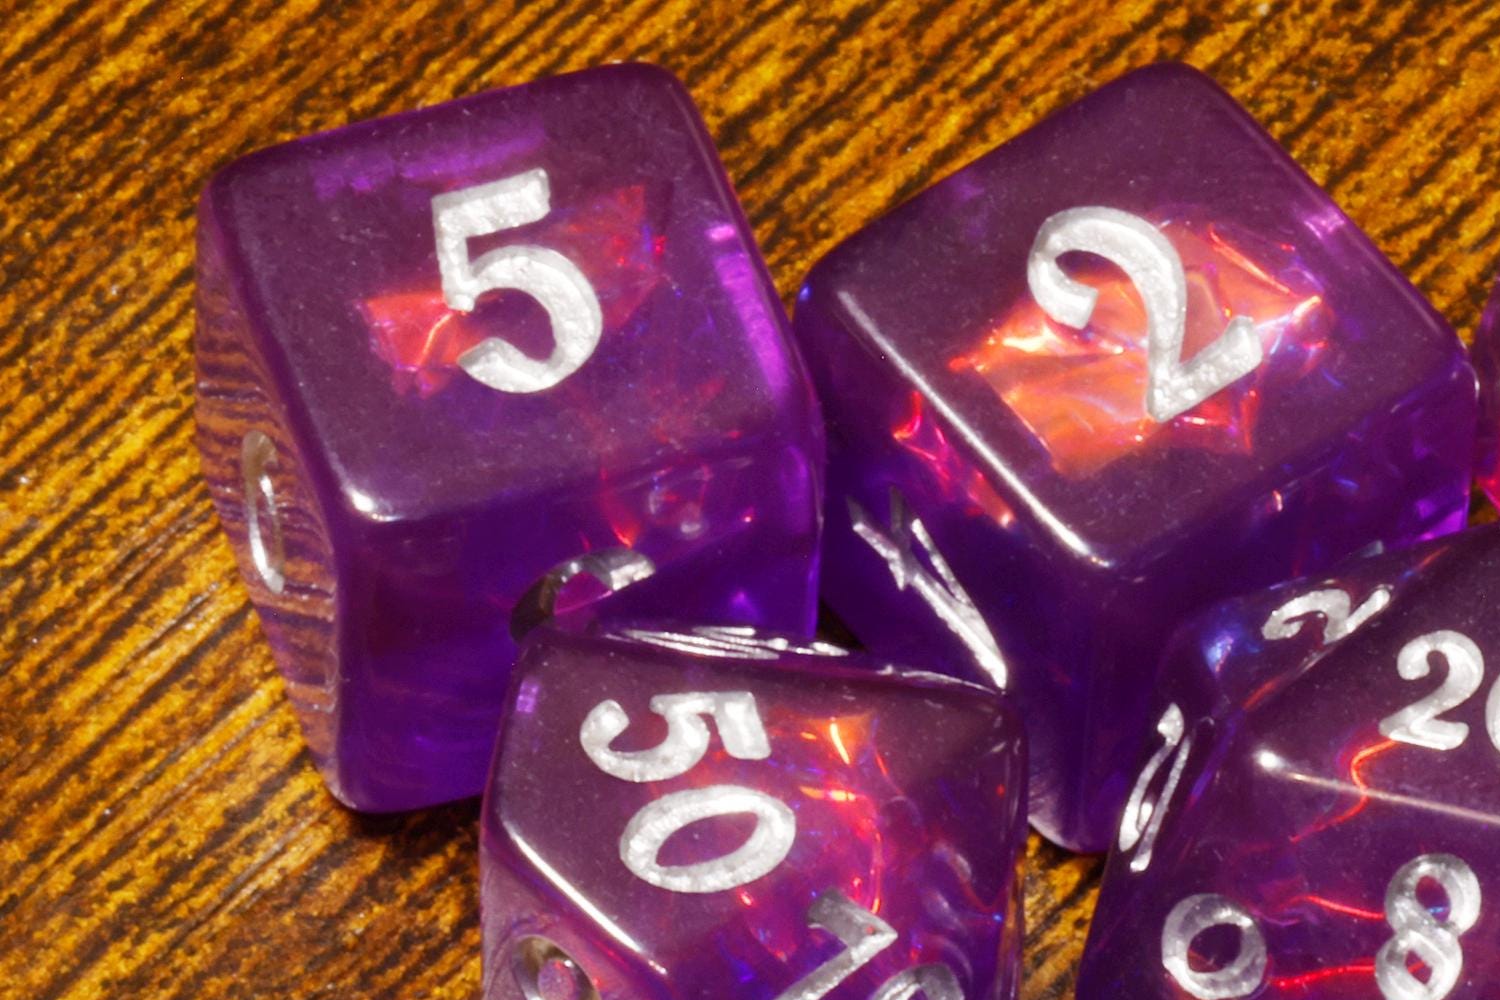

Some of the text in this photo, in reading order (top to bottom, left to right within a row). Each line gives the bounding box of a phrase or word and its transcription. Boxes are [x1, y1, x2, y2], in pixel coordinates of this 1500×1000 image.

[432, 168, 602, 393] 5
[1028, 206, 1262, 422] 2
[580, 692, 796, 893] 50
